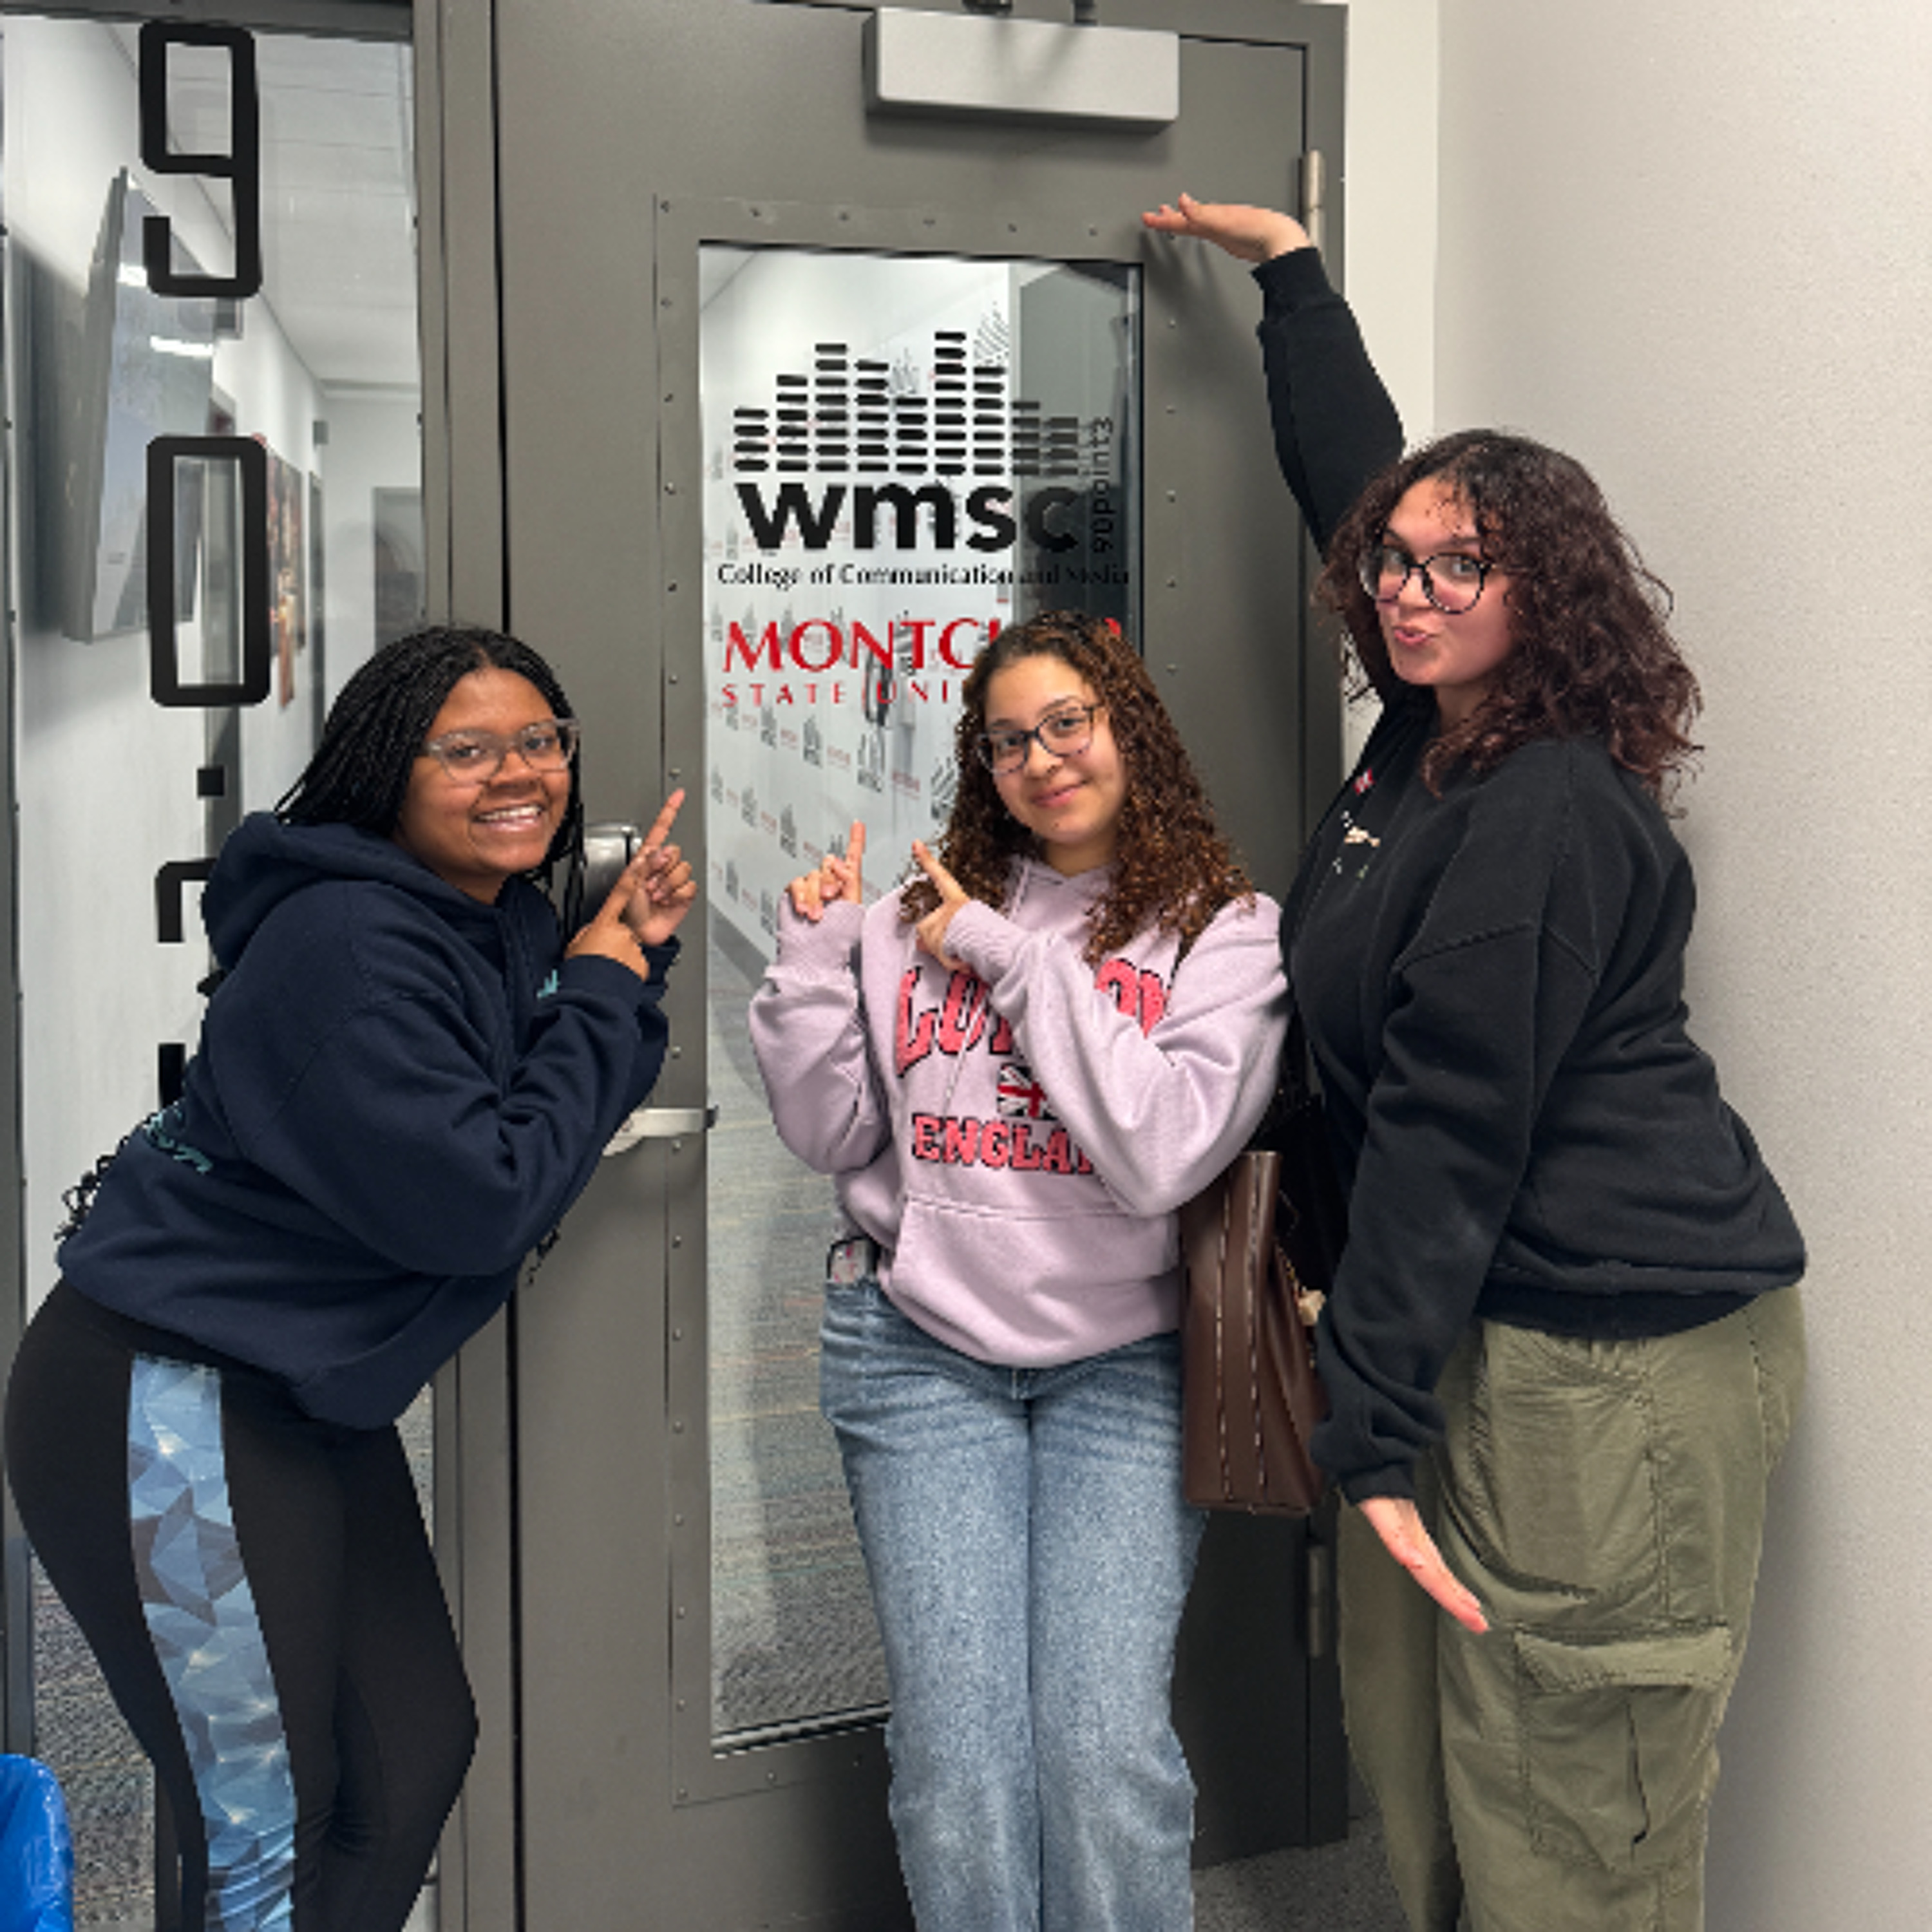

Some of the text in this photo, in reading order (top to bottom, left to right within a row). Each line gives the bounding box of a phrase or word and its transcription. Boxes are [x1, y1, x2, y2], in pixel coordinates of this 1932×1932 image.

[1089, 416, 1117, 554] 90point3
[734, 482, 1079, 552] wmsc
[717, 563, 1130, 591] College of Communication and Media
[723, 617, 1121, 673] MONTC
[721, 679, 967, 708] STATE UNI
